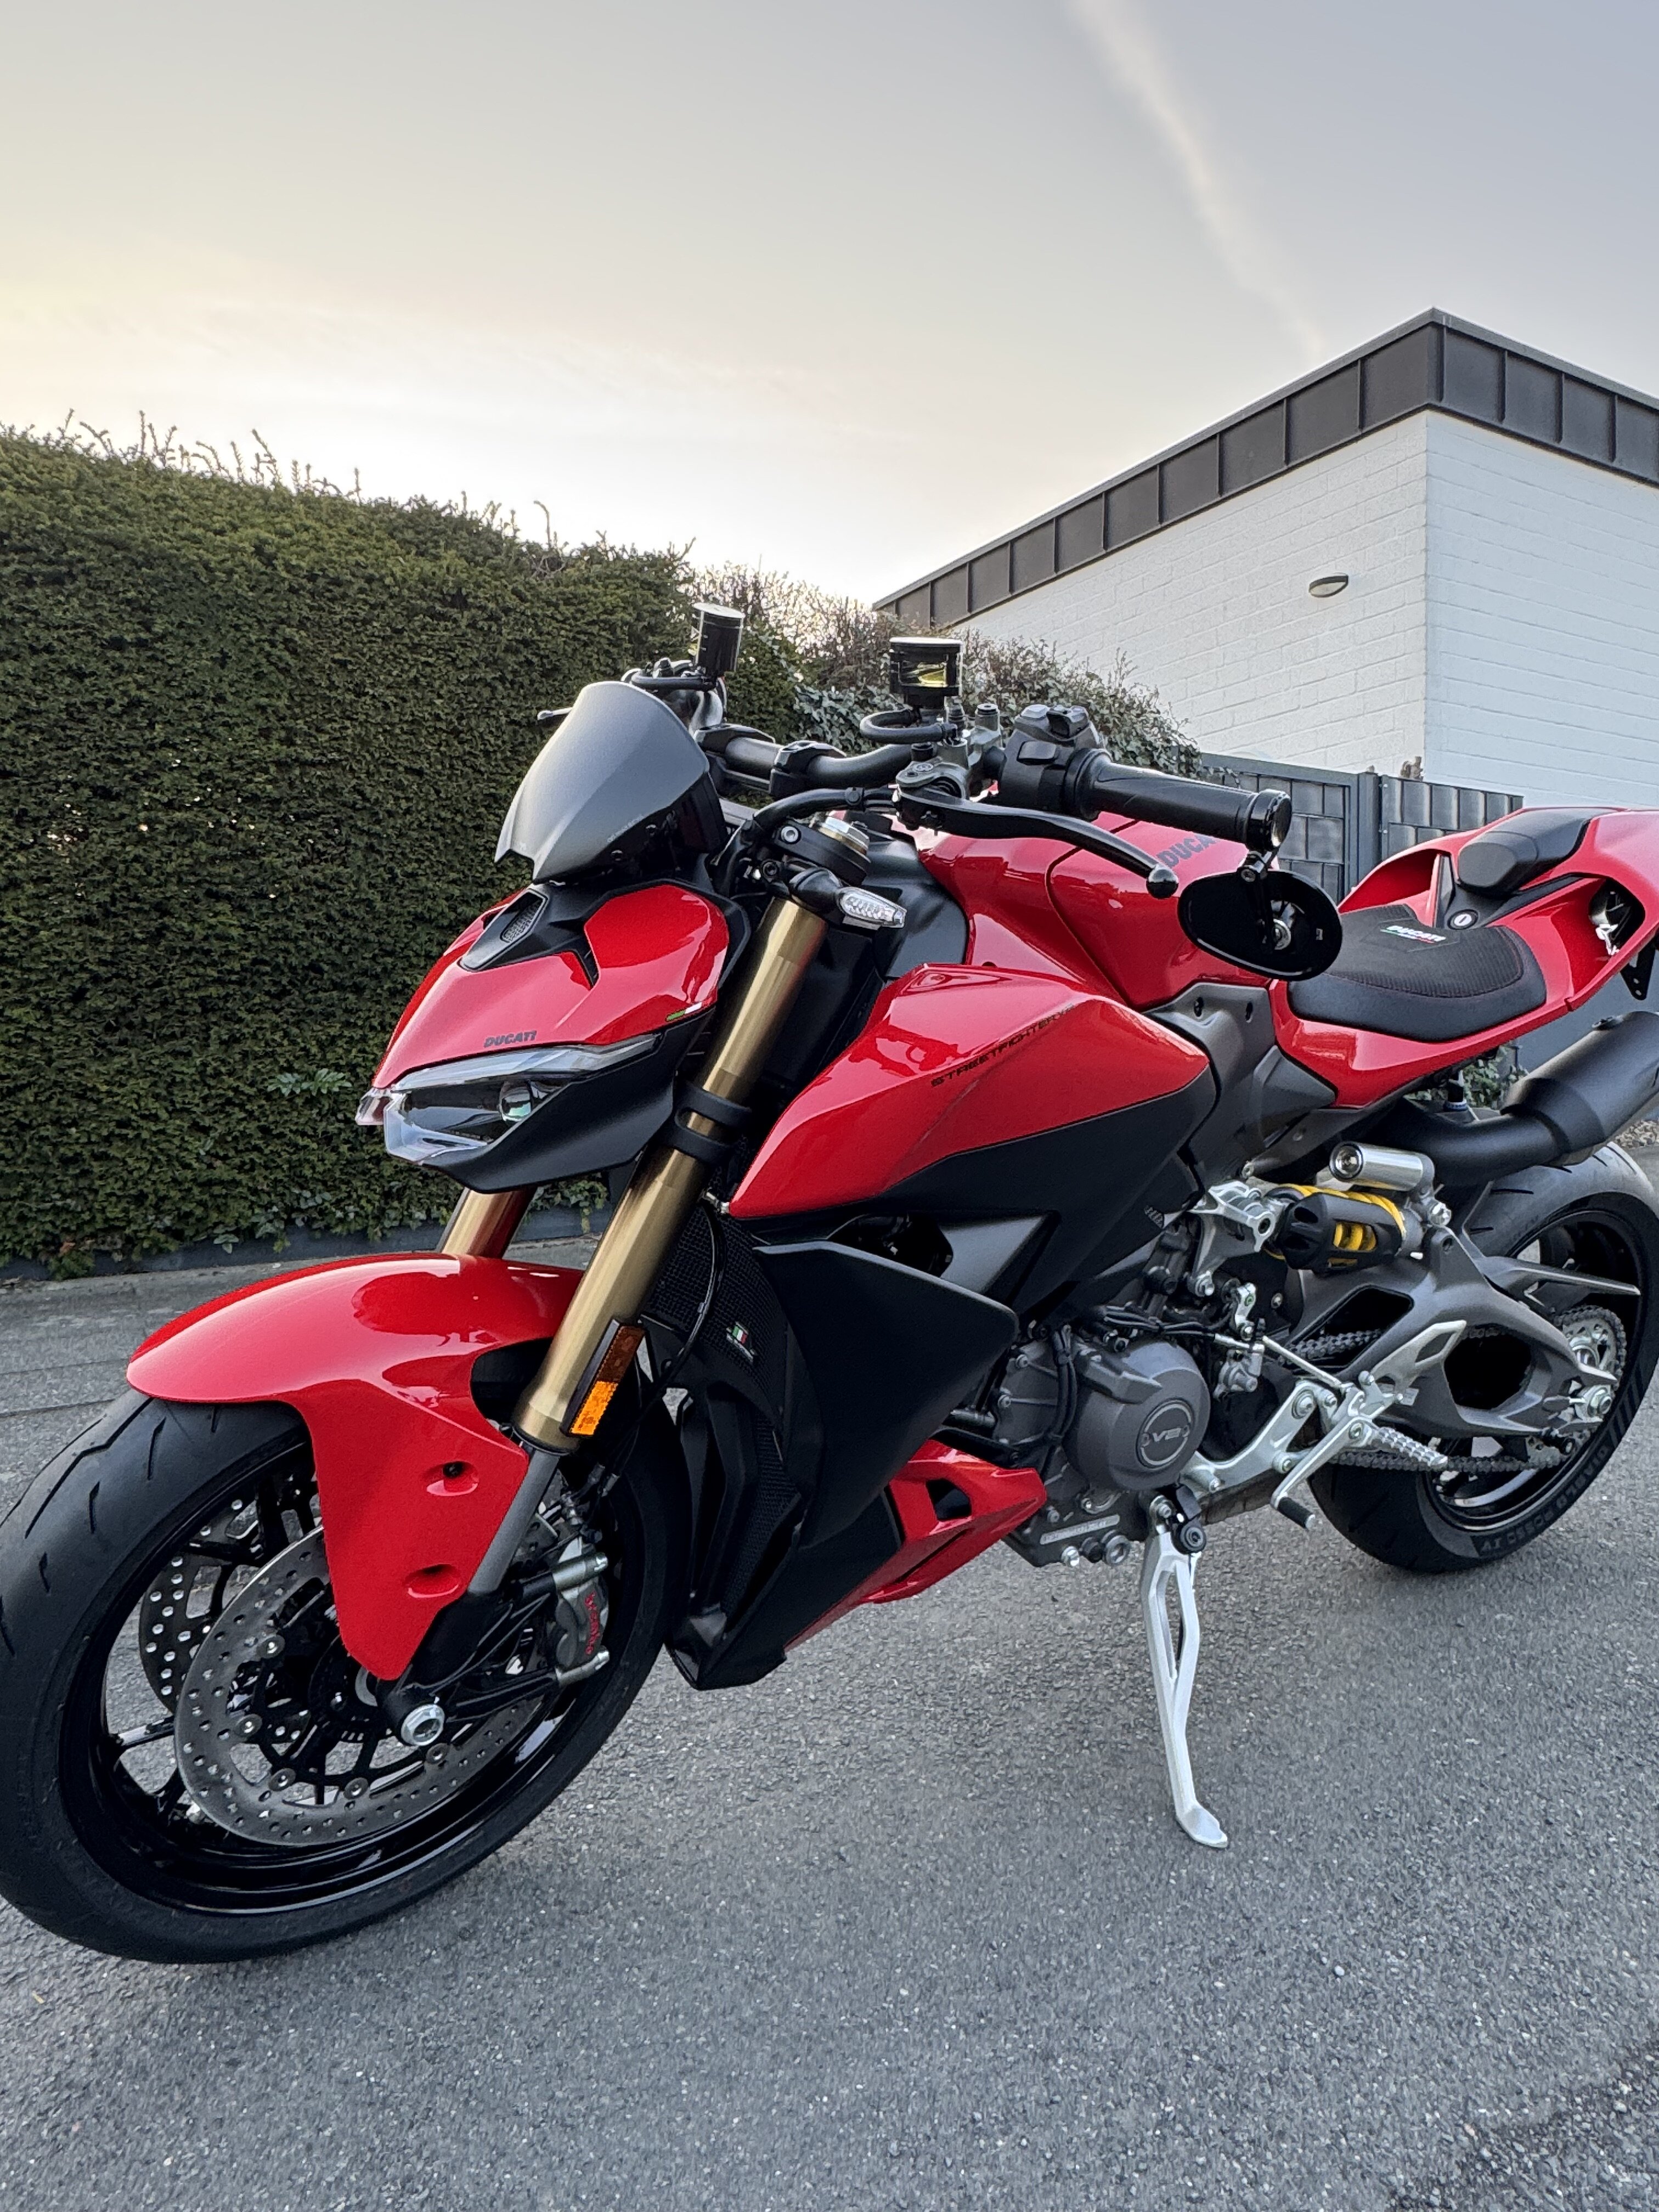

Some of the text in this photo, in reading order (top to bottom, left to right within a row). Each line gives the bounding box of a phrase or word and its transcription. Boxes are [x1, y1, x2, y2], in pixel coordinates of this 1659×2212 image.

[1156, 834, 1216, 868] DUCA
[484, 1030, 537, 1048] DUCATI
[1153, 1427, 1182, 1442] V2
